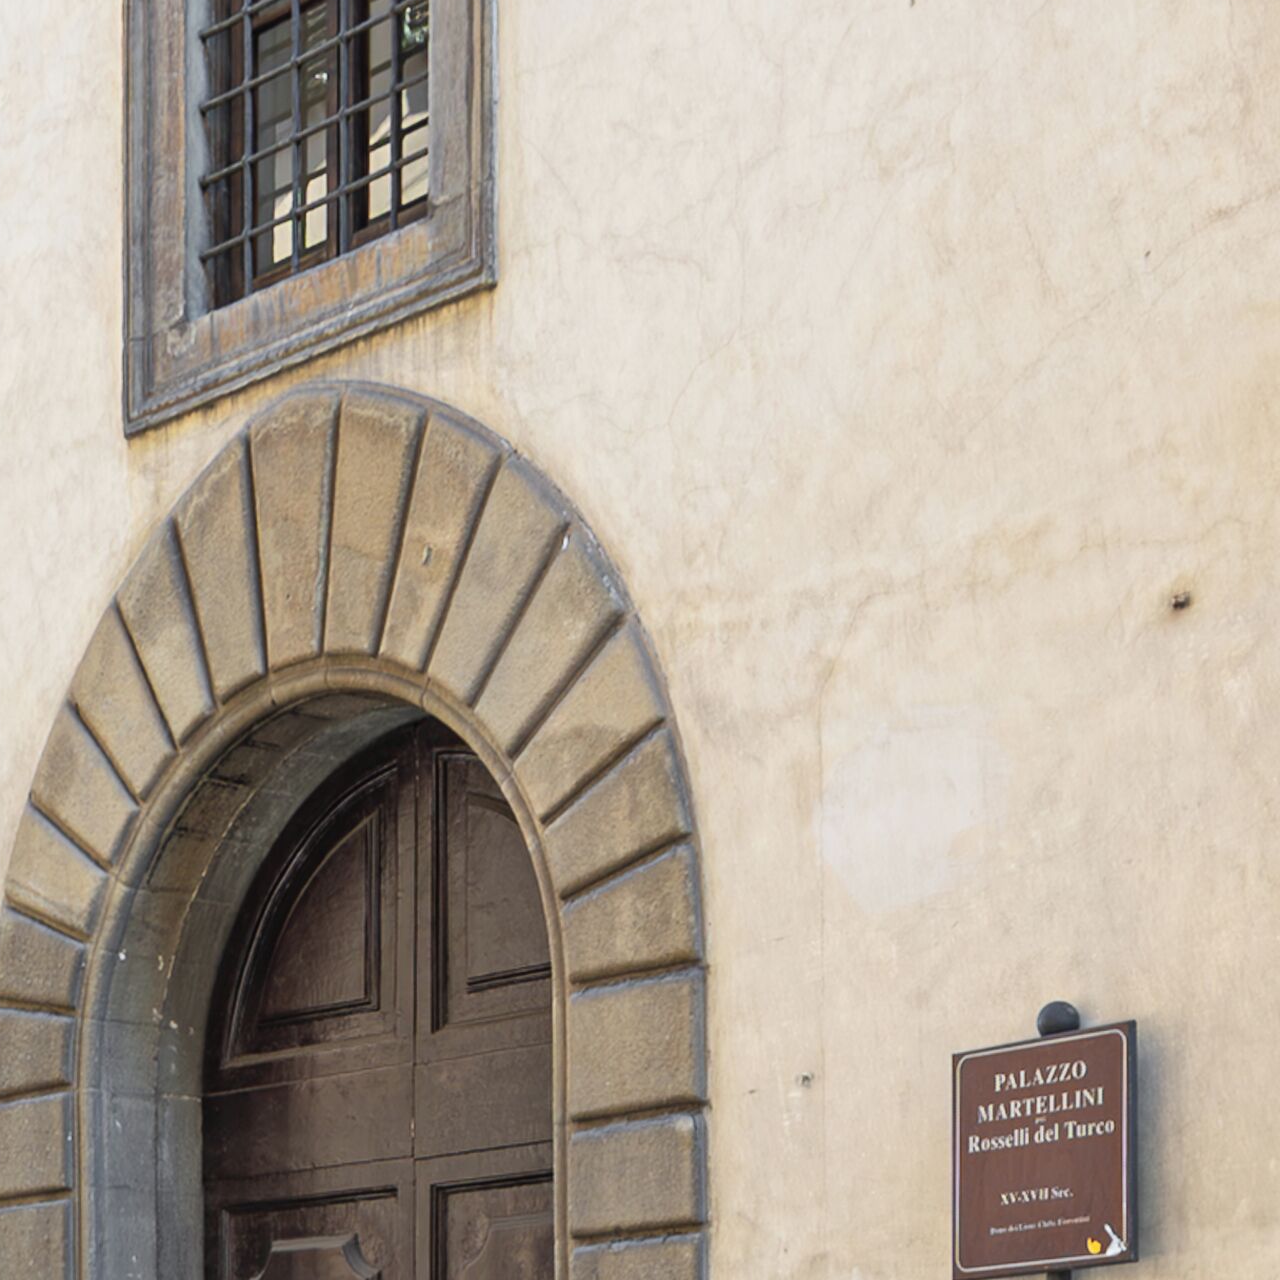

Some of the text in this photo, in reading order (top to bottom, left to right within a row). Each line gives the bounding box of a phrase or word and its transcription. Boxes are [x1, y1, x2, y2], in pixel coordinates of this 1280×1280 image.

[994, 1060, 1087, 1092] PALAZZO
[977, 1086, 1104, 1124] MARTELLINI
[968, 1119, 1115, 1154] Rosselli del Turco
